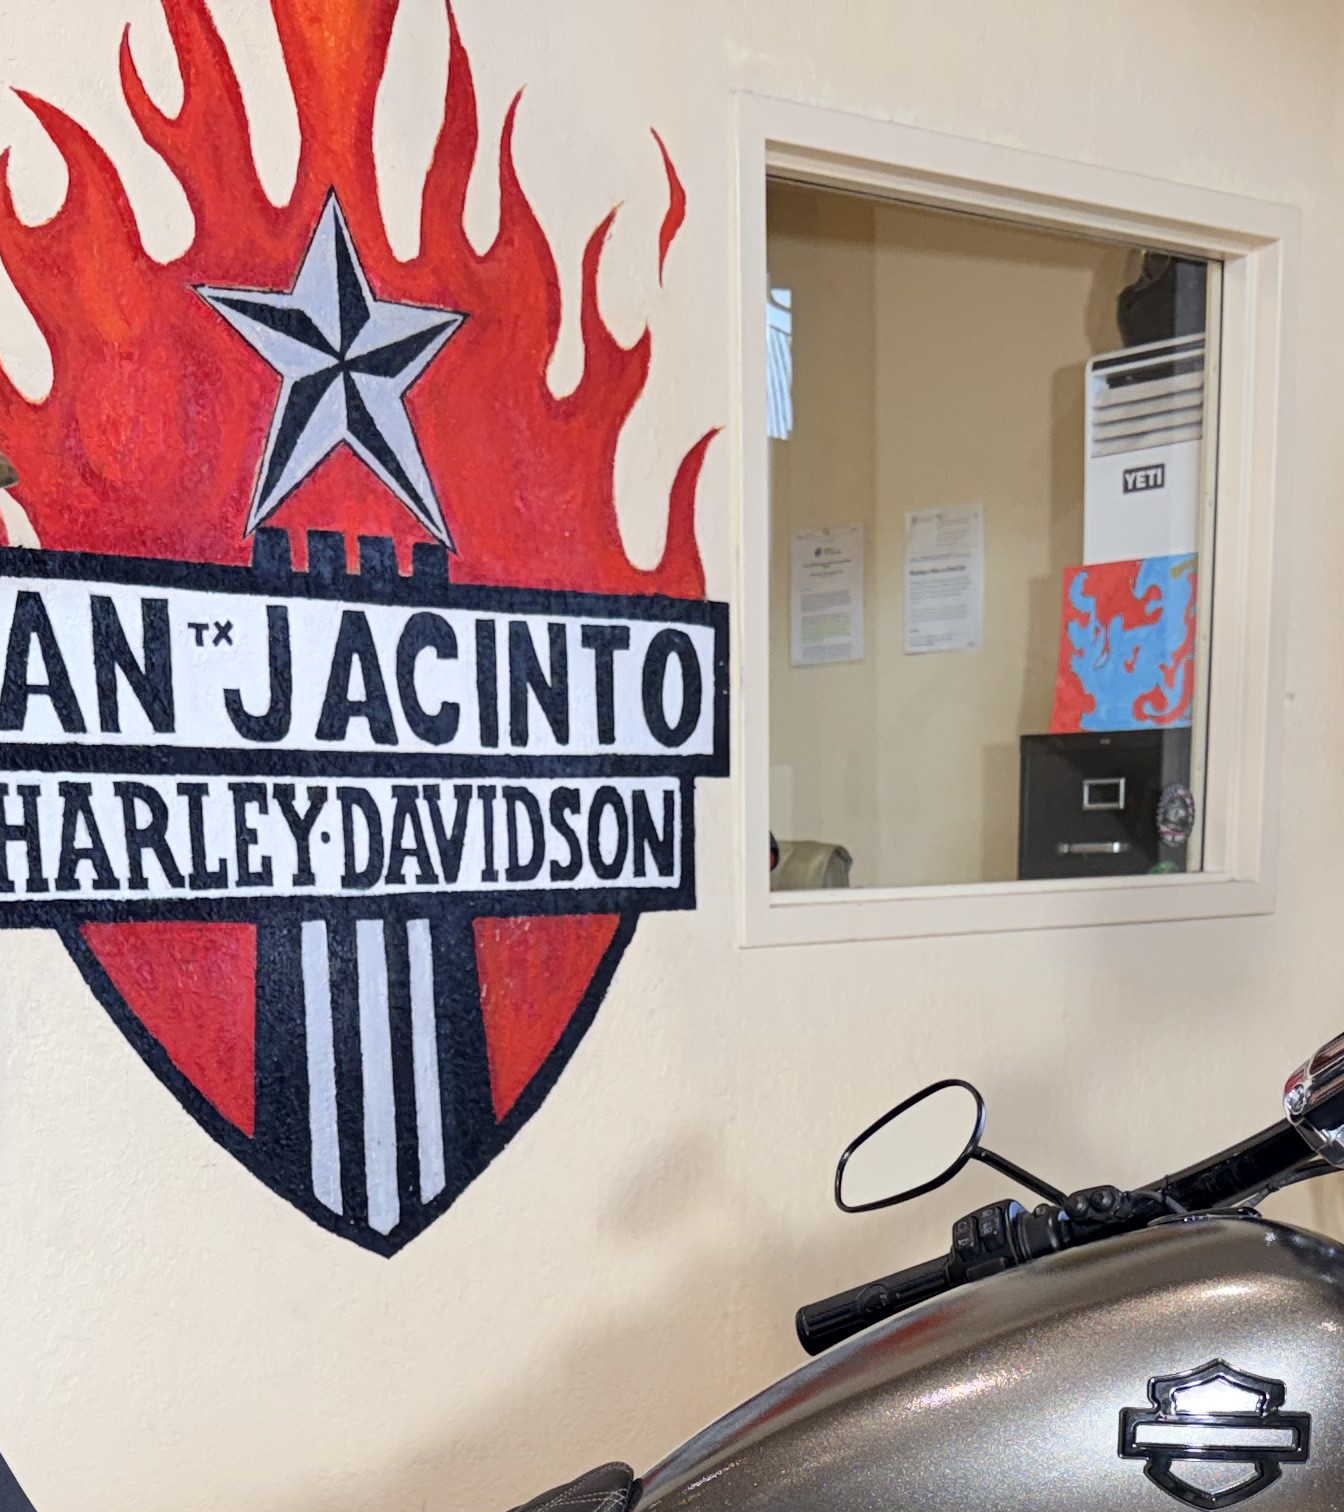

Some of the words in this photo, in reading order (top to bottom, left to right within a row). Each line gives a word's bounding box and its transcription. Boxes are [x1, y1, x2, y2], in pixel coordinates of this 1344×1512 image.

[1124, 468, 1162, 490] YETI
[187, 619, 234, 648] TX
[223, 604, 702, 748] JACINTO
